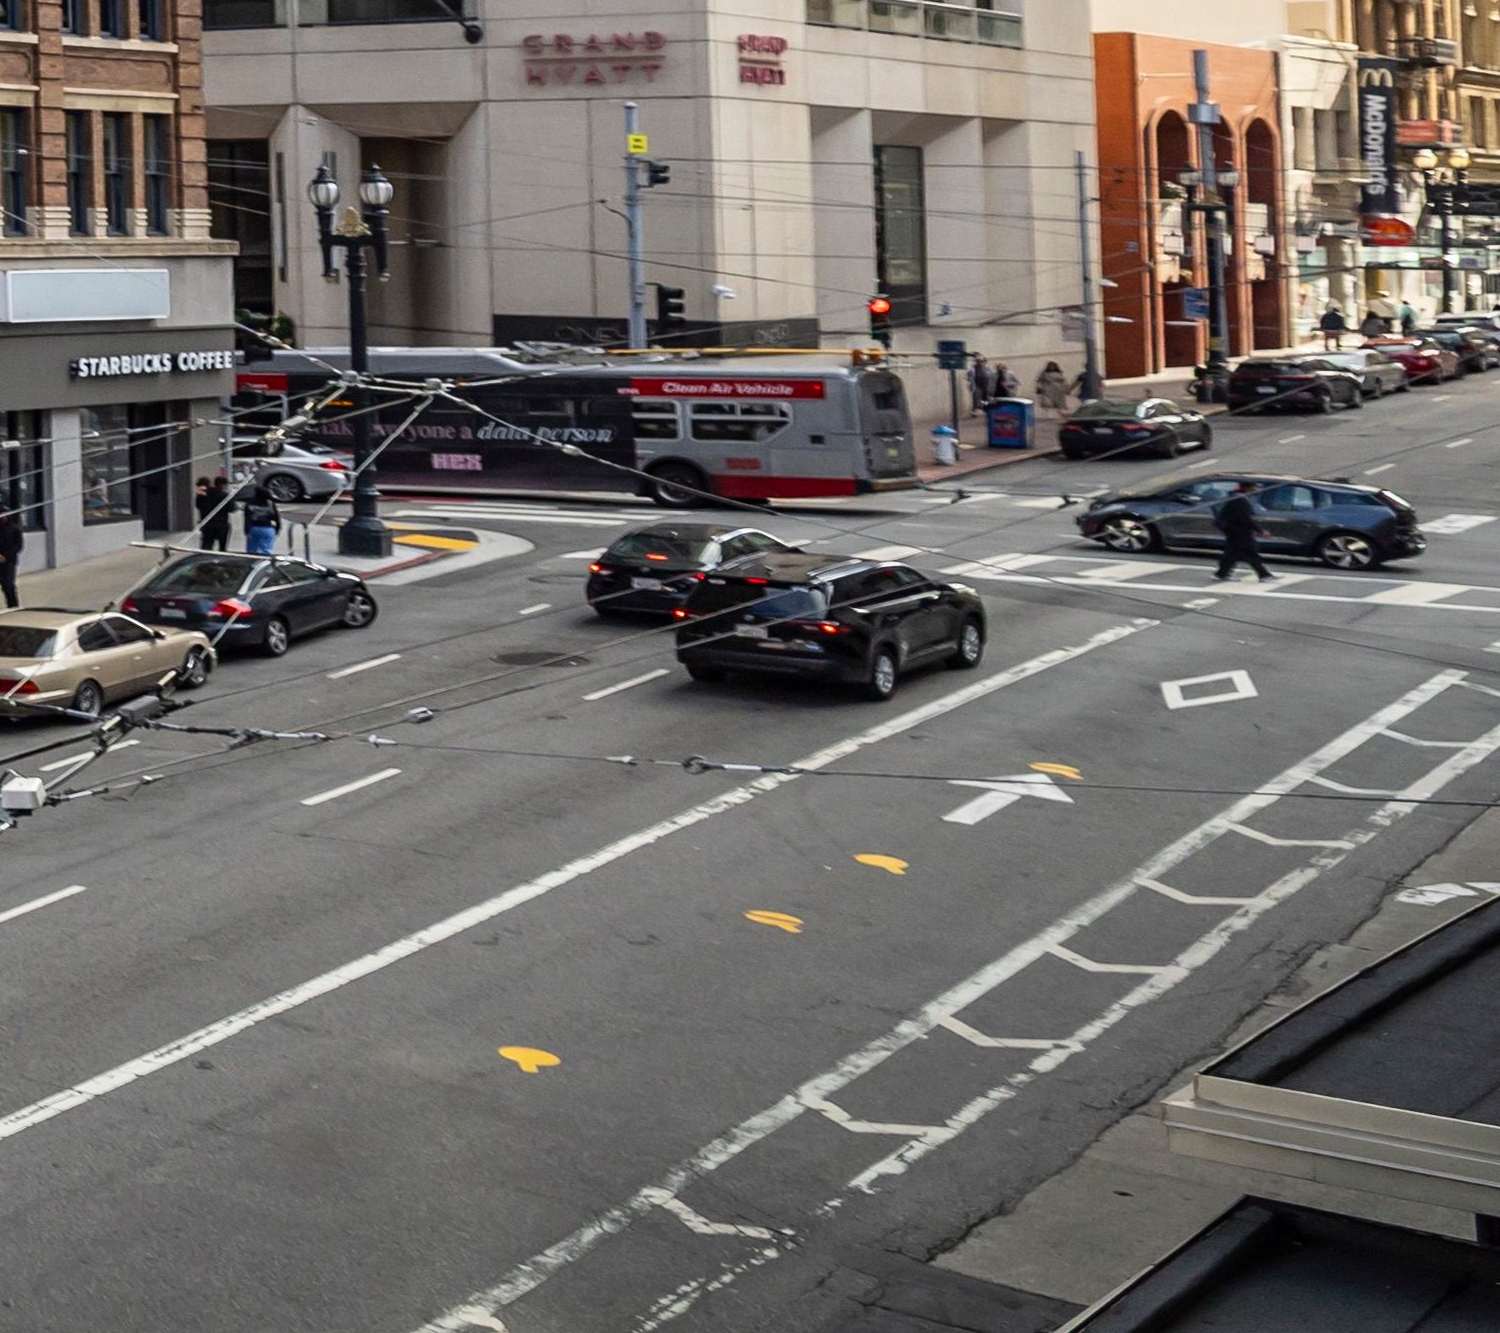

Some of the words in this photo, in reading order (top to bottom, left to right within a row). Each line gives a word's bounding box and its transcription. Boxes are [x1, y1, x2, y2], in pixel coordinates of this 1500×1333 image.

[522, 30, 666, 55] GRAND
[525, 63, 662, 86] HYATT
[1362, 93, 1387, 196] McDonald's
[77, 352, 173, 378] STARBUCKS
[177, 350, 234, 372] COFFEE
[661, 381, 707, 394] Clean
[708, 382, 732, 394] Air
[735, 382, 794, 396] Vehicle
[477, 421, 531, 441] data
[532, 426, 614, 446] person
